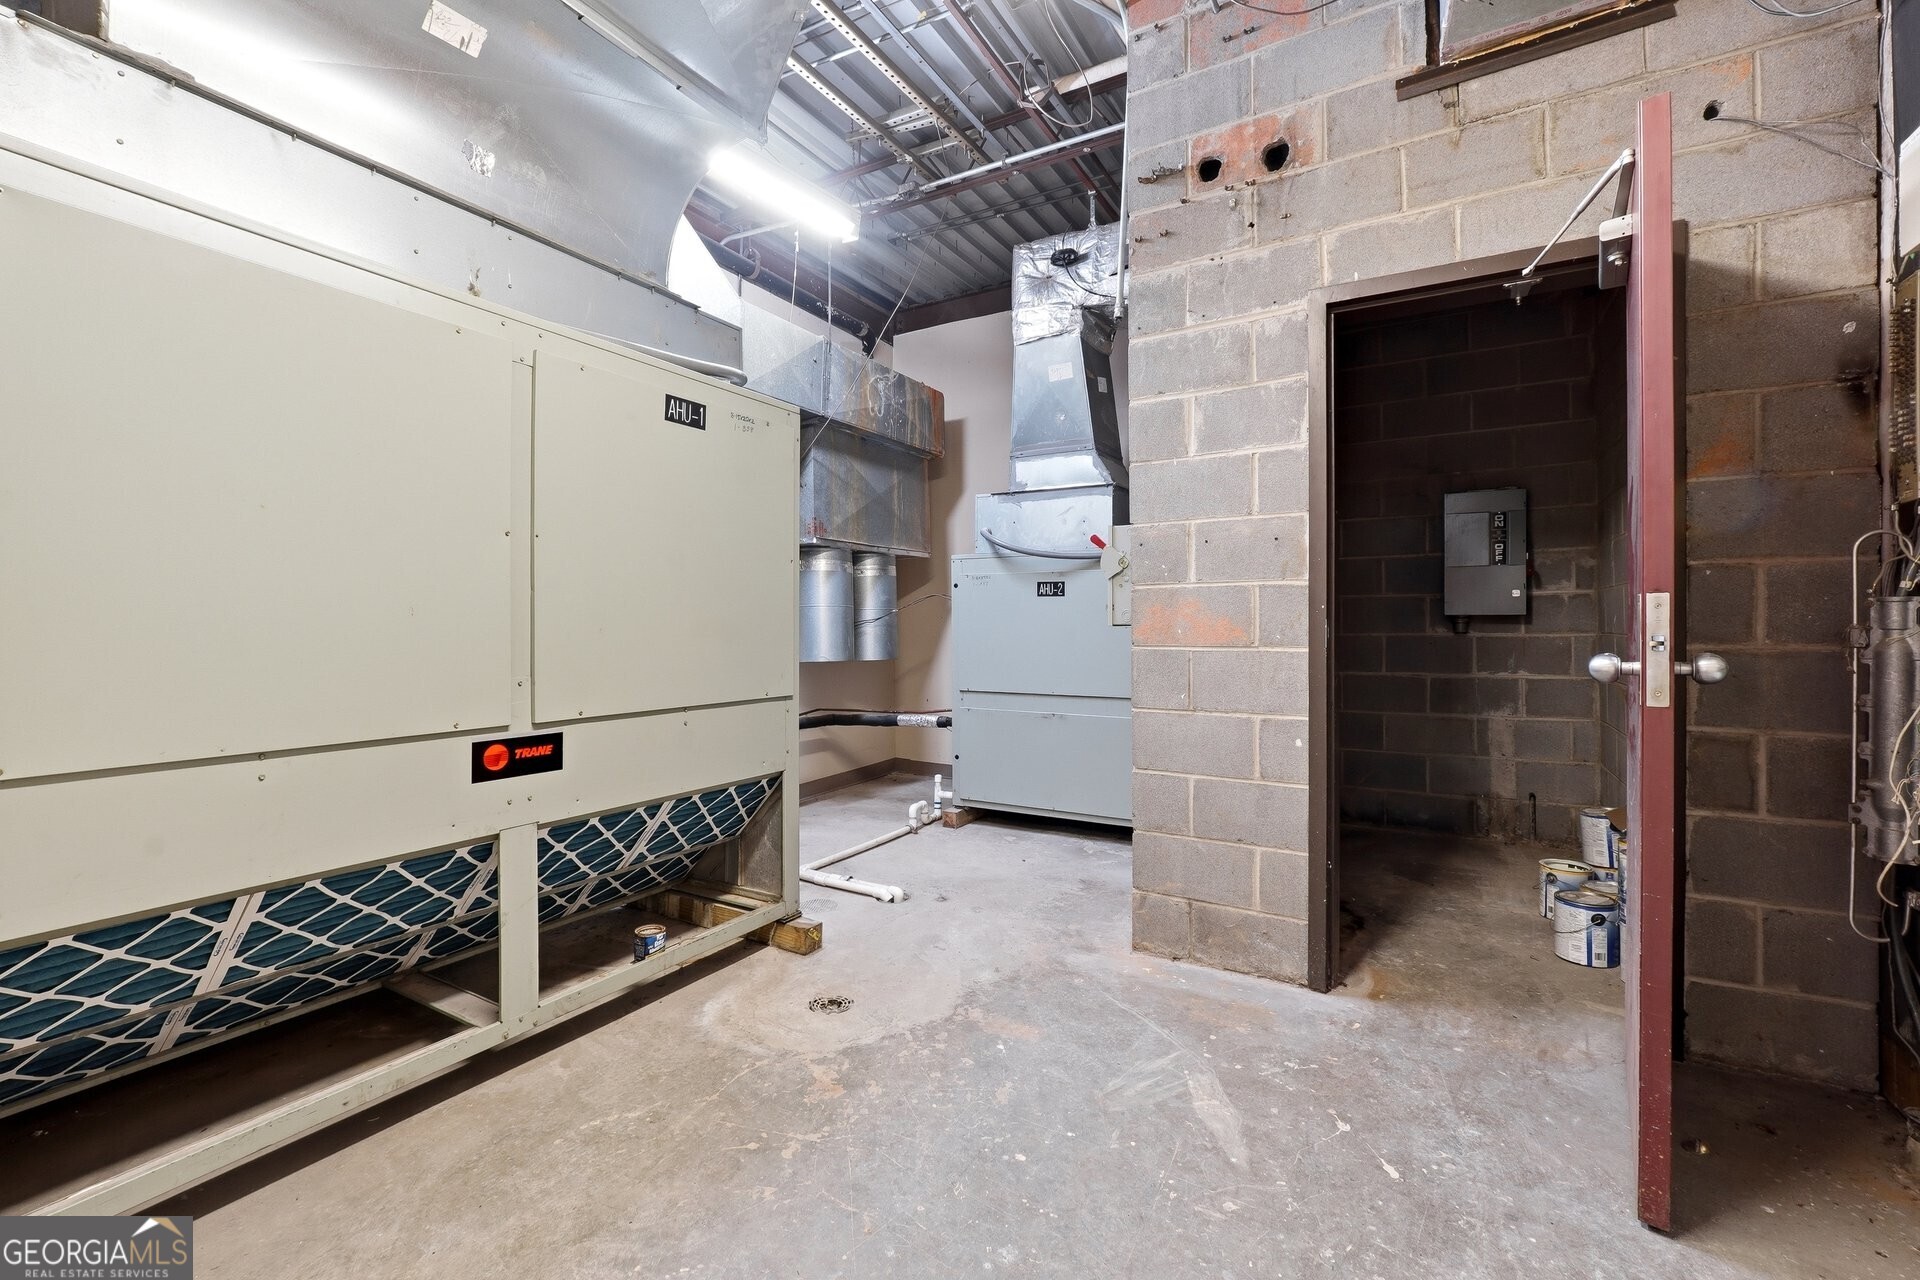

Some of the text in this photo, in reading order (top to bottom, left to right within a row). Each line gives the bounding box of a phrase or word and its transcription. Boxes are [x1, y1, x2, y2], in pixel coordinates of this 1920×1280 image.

[667, 398, 704, 427] AHU-1
[1494, 514, 1504, 527] ON
[1494, 543, 1504, 562] OFF
[1038, 582, 1063, 596] AHU-2
[514, 744, 554, 759] TRANE
